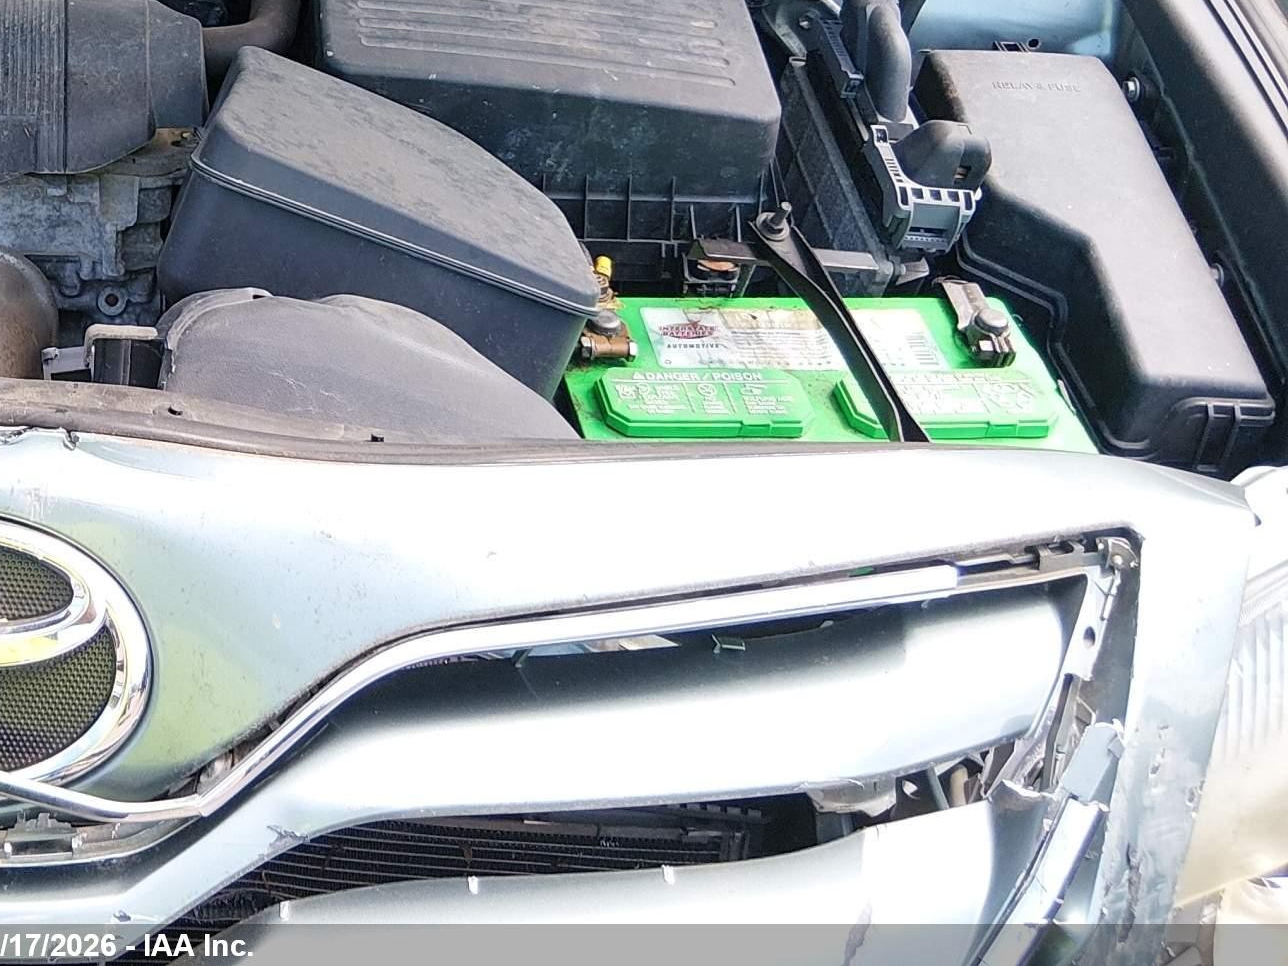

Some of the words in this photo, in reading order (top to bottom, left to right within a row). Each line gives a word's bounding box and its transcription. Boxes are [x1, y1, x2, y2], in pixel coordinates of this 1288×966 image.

[991, 81, 1032, 91] RELAY
[1047, 82, 1082, 93] FUSE
[658, 324, 718, 332] INTERSTATE
[644, 371, 698, 381] DANGER
[712, 371, 763, 382] POISON
